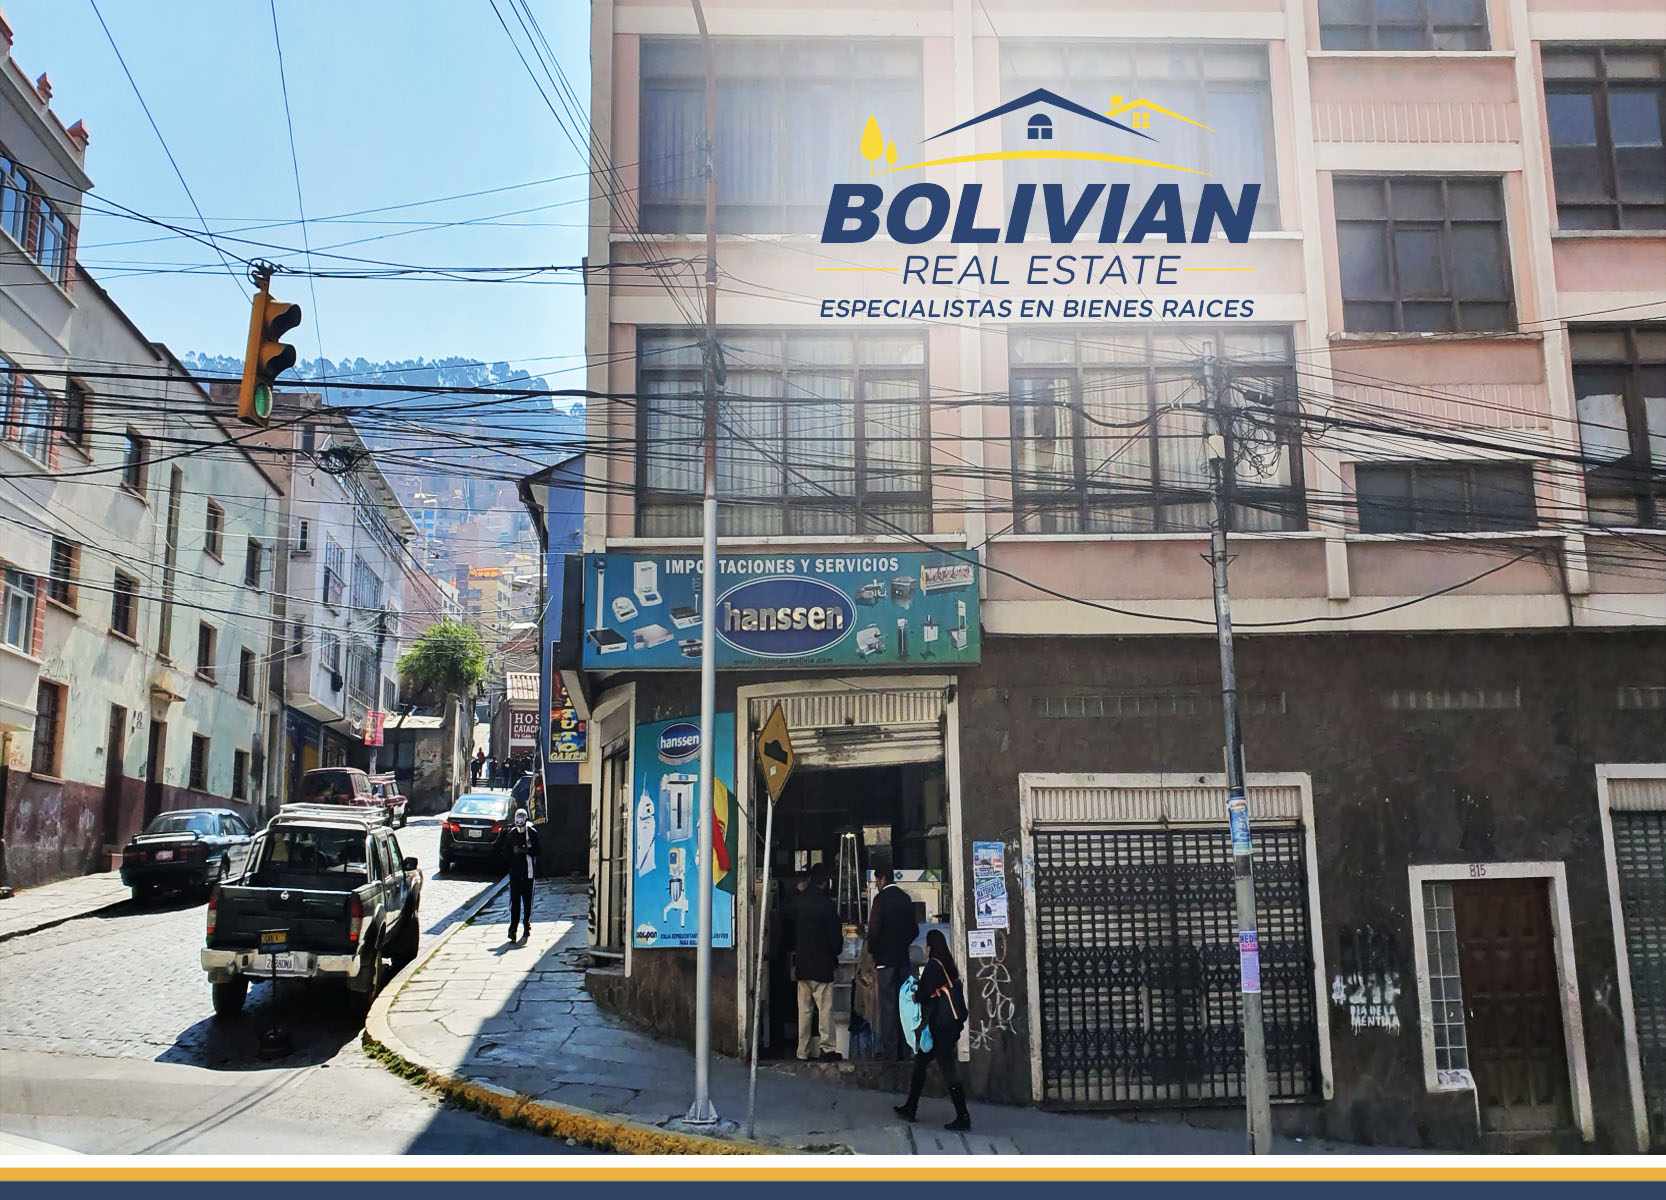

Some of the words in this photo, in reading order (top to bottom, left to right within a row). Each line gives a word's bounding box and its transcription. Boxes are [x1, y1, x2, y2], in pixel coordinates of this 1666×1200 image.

[665, 558, 796, 575] IMPOTACIONES
[801, 558, 812, 574] Y
[815, 557, 899, 573] SERVICIOS
[722, 601, 844, 632] hanssen
[660, 735, 700, 749] hanssen
[1469, 864, 1487, 878] 815
